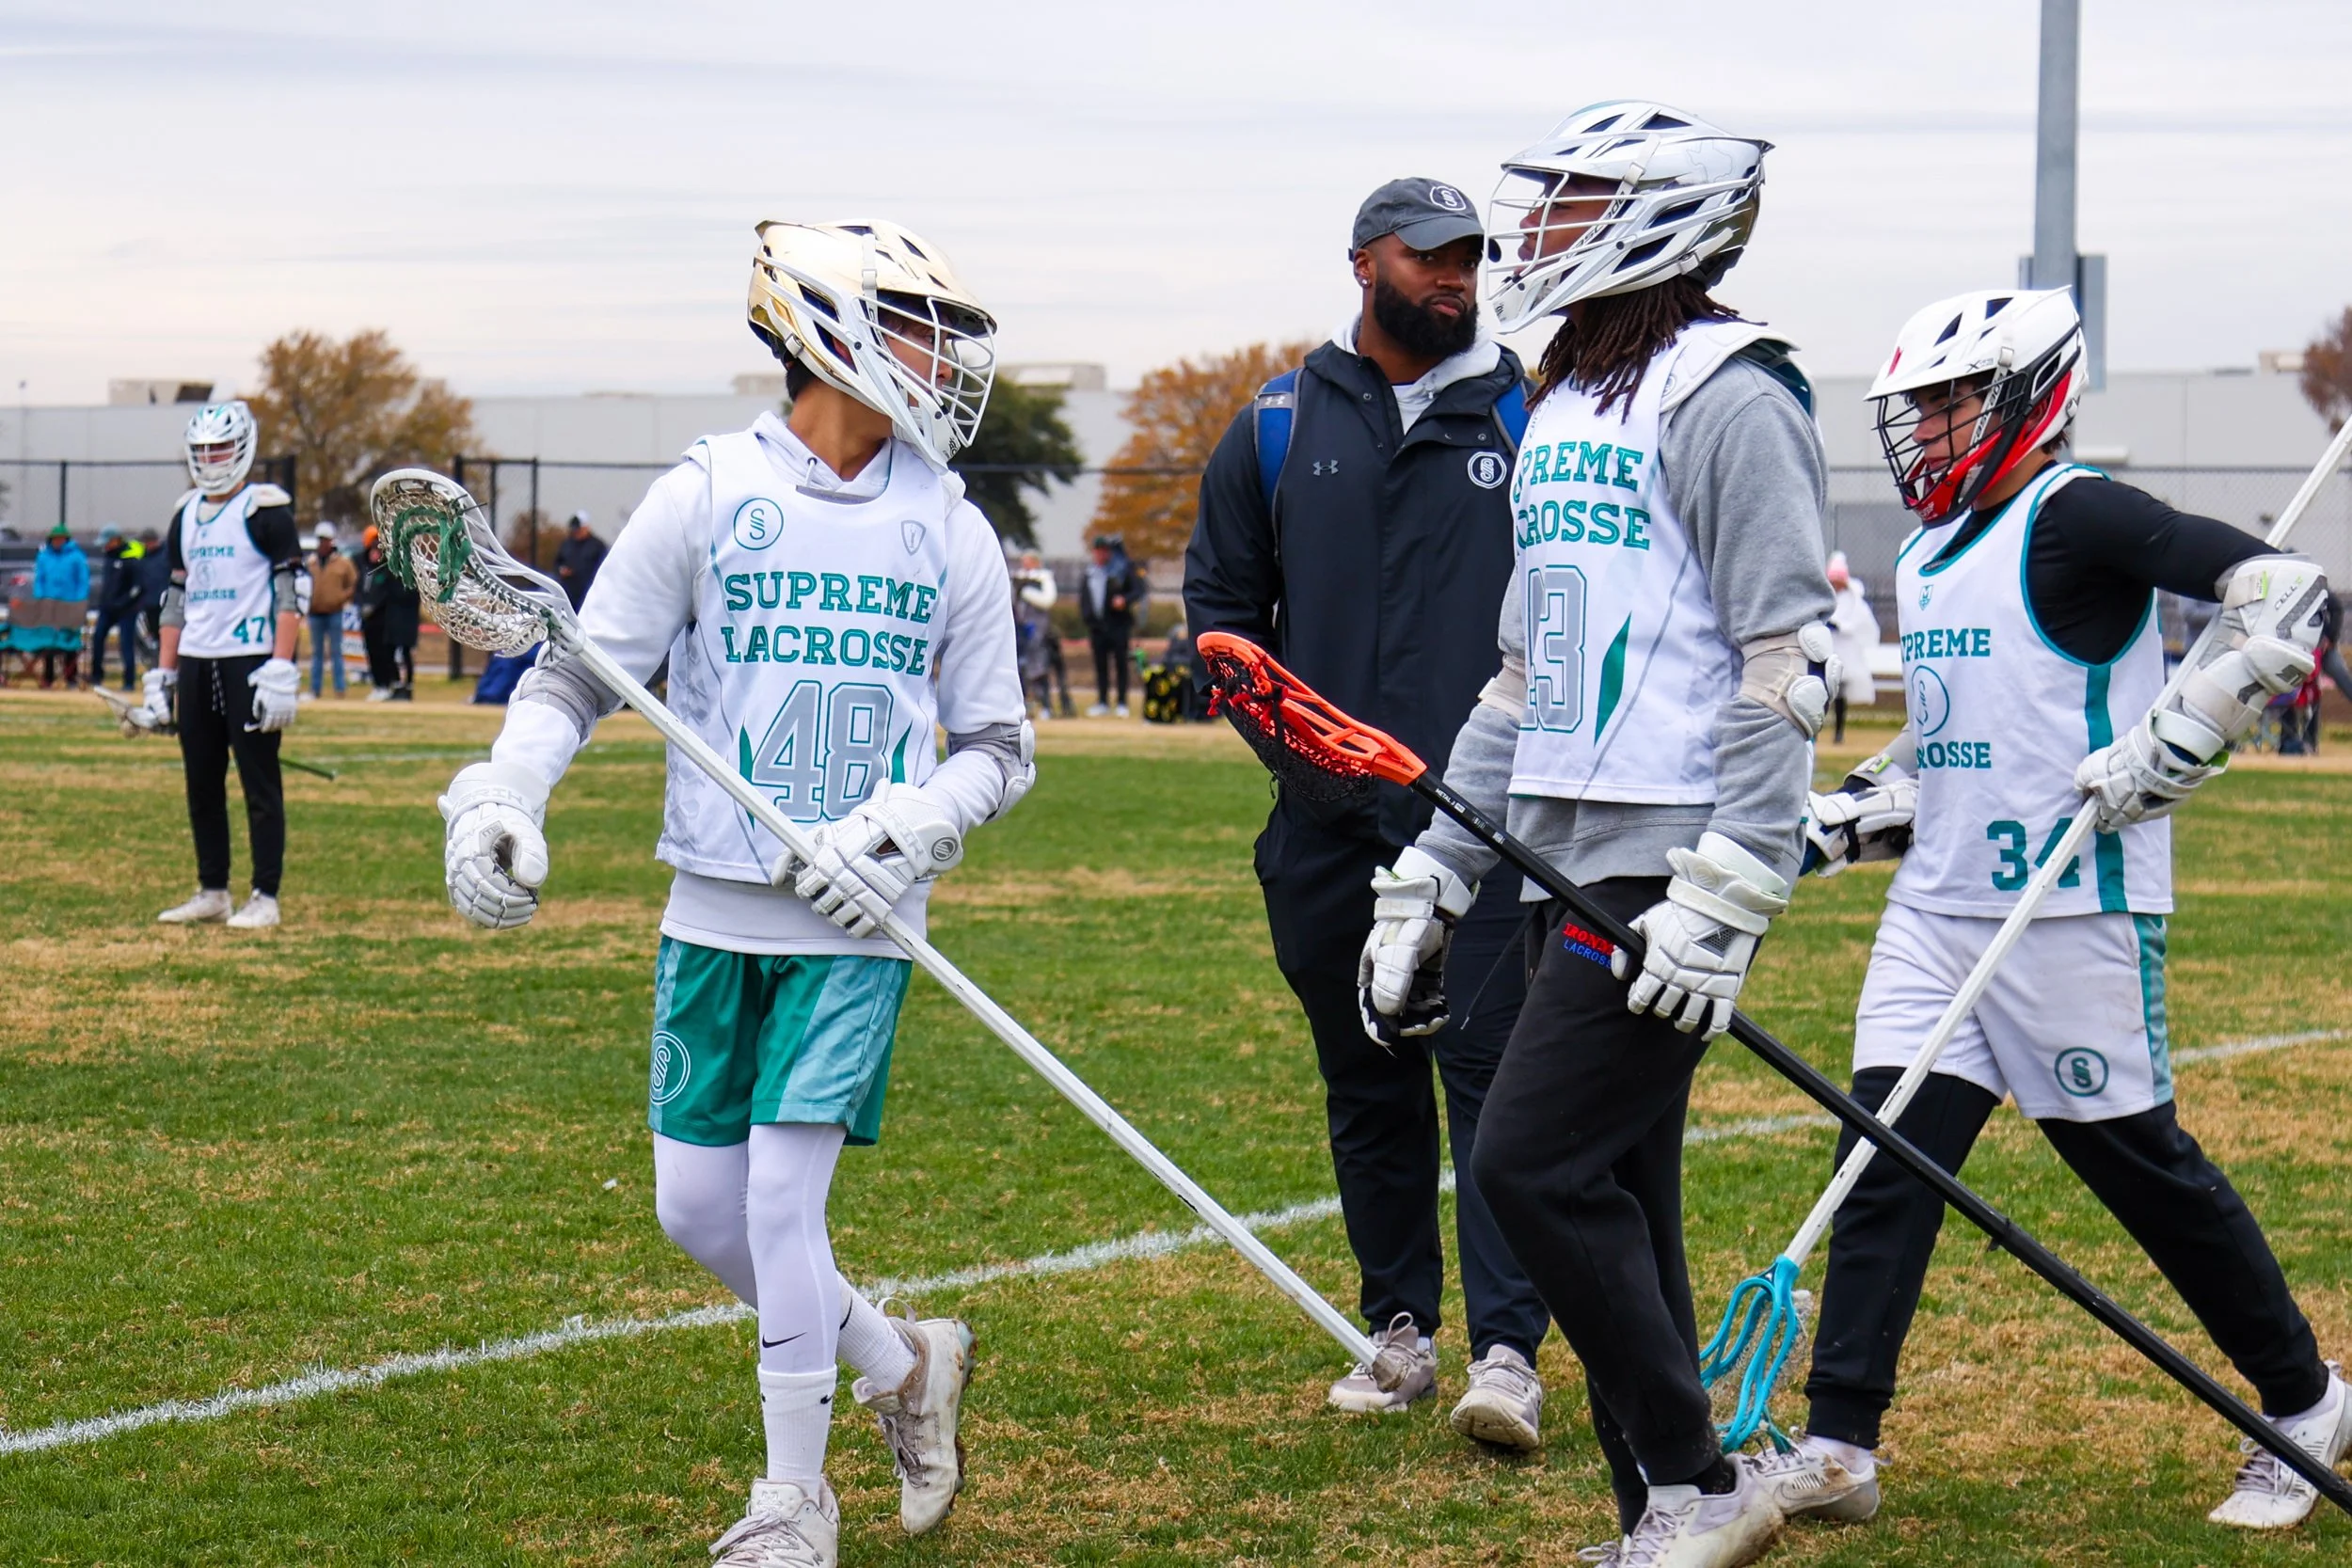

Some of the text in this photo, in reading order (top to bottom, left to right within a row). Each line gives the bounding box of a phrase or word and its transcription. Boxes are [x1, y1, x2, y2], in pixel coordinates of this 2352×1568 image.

[1513, 441, 1644, 503] PREME
[1518, 499, 1651, 551] CROSSE
[724, 571, 937, 624] SUPREME
[233, 617, 265, 643] 47
[721, 626, 928, 676] LACROSSE
[1901, 628, 1991, 663] PREME
[753, 680, 895, 823] 48
[1916, 741, 1992, 769] ROSSE
[1987, 817, 2080, 891] 34
